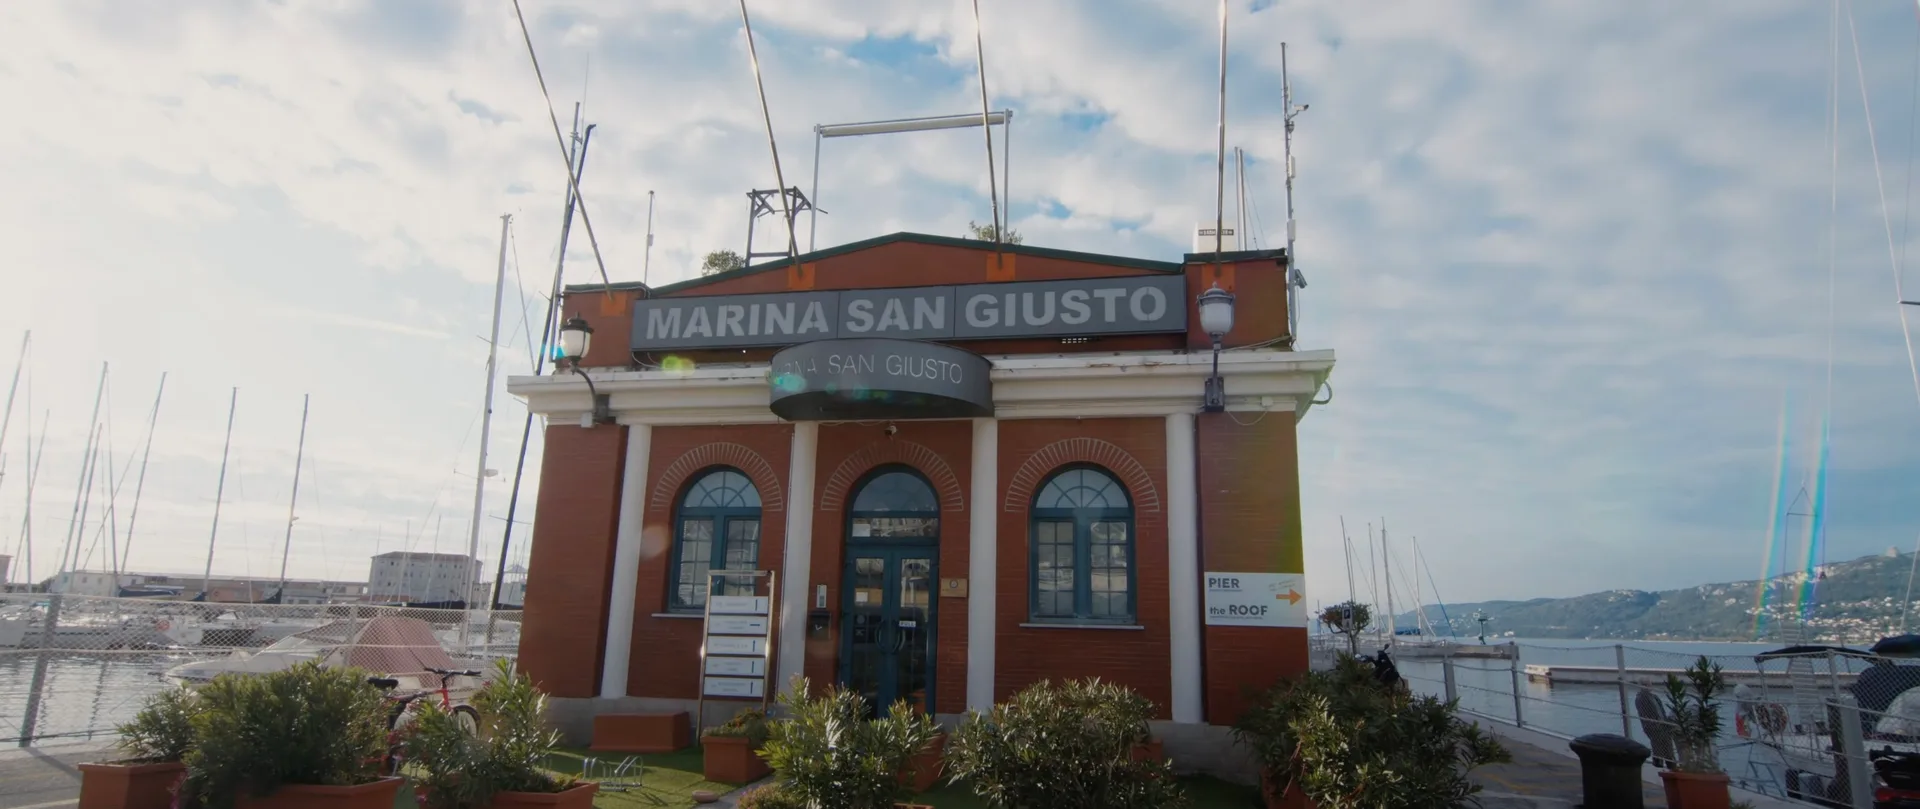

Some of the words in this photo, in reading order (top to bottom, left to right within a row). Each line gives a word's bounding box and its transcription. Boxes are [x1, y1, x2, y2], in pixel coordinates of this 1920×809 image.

[646, 301, 829, 340] MARINA
[846, 296, 945, 332] SAN
[965, 286, 1167, 328] GIUSTO
[828, 354, 874, 374] SAN
[886, 354, 963, 384] GIUSTO
[1208, 577, 1240, 589] PIER
[1209, 606, 1226, 615] the
[1228, 604, 1268, 616] ROOF
